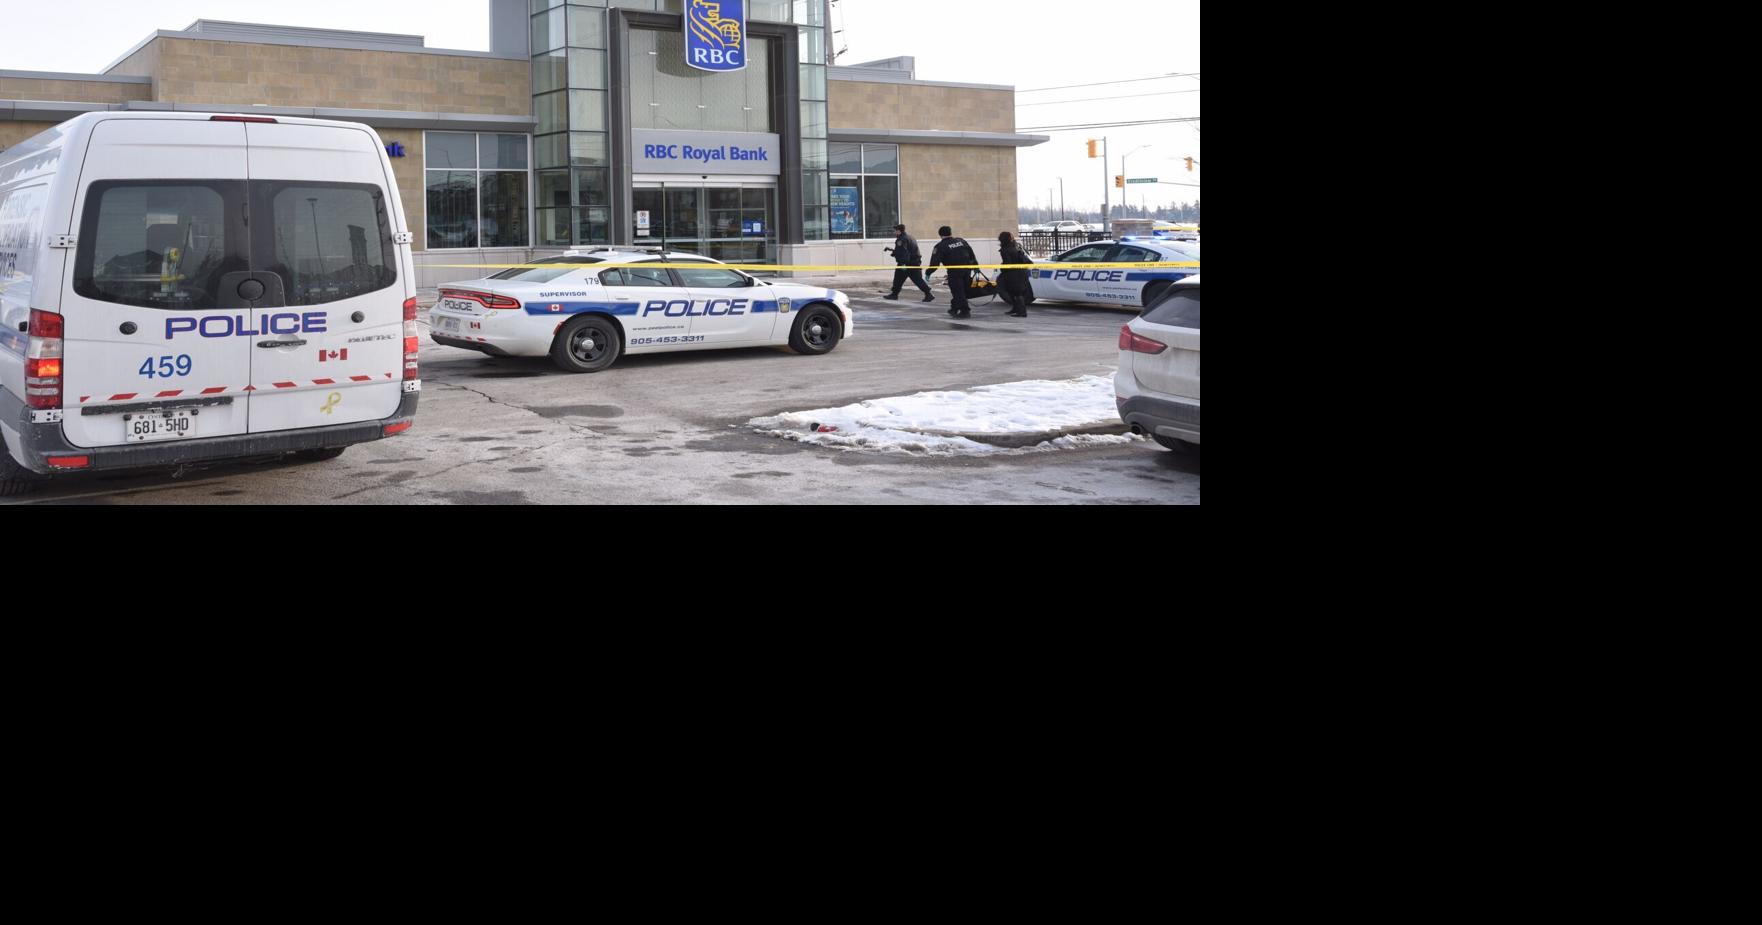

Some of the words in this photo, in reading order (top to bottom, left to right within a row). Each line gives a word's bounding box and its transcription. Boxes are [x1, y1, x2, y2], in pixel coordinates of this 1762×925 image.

[693, 47, 740, 65] RBC
[644, 144, 678, 159] RBC
[682, 145, 726, 163] Royal
[729, 147, 768, 161] Bank
[584, 277, 600, 285] 179
[1054, 270, 1123, 282] POLICE
[1085, 292, 1136, 300] 905-453-3311
[445, 299, 473, 311] POLICE
[642, 298, 749, 317] POLICE
[165, 312, 328, 339] POLICE
[630, 335, 705, 345] 905-453-3311
[138, 354, 192, 378] 459
